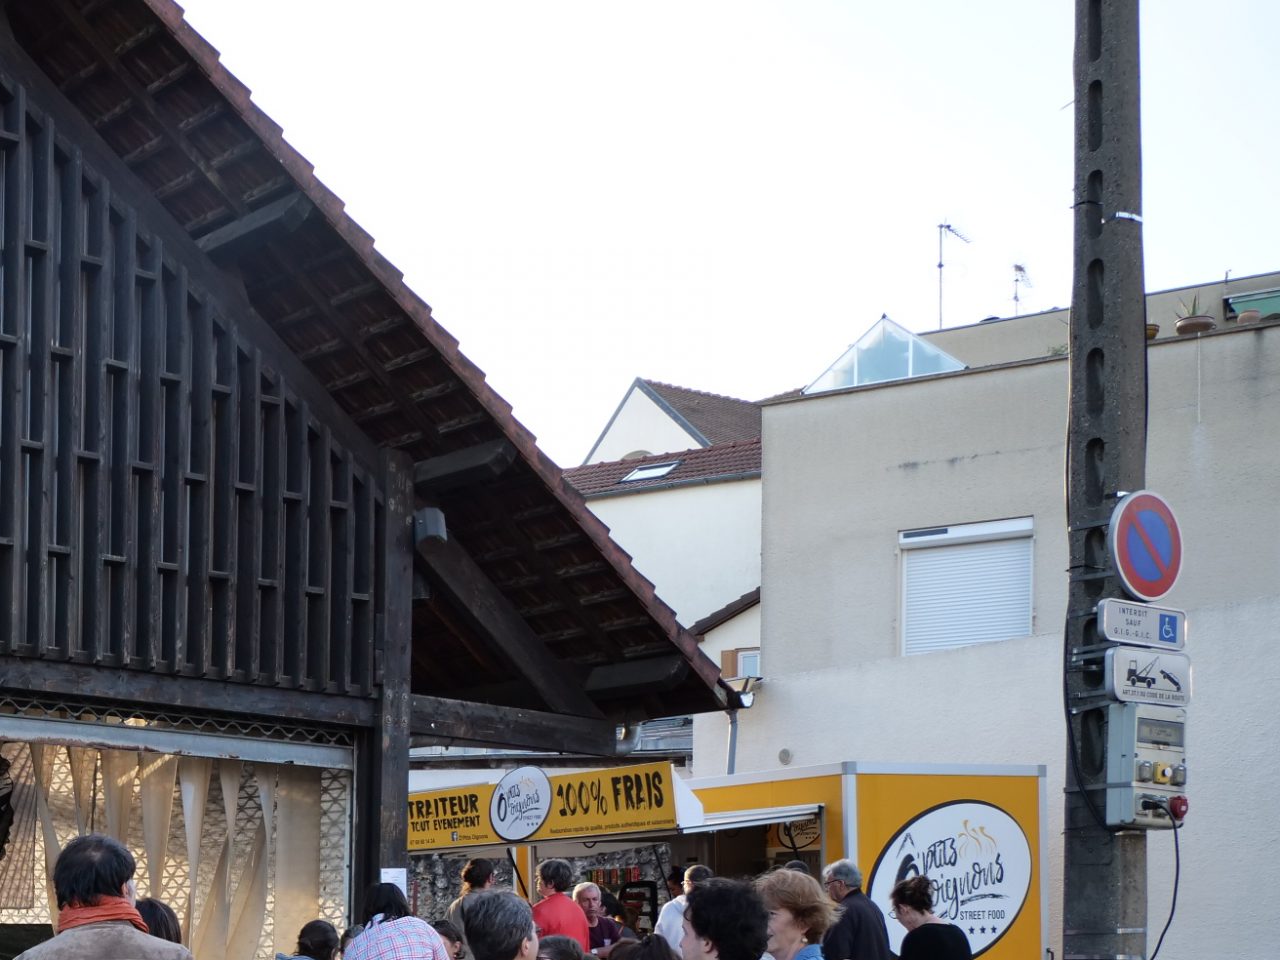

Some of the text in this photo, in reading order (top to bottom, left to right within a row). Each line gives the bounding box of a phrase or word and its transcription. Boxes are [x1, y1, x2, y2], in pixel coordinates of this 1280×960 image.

[1118, 607, 1148, 617] INTERDIT
[1125, 618, 1142, 627] SAUF
[556, 770, 663, 817] 100% FRAIS
[408, 793, 479, 819] TRAITEUR
[411, 815, 480, 832] TOUT EVENEMENT
[959, 909, 1006, 921] STREET FOOD
